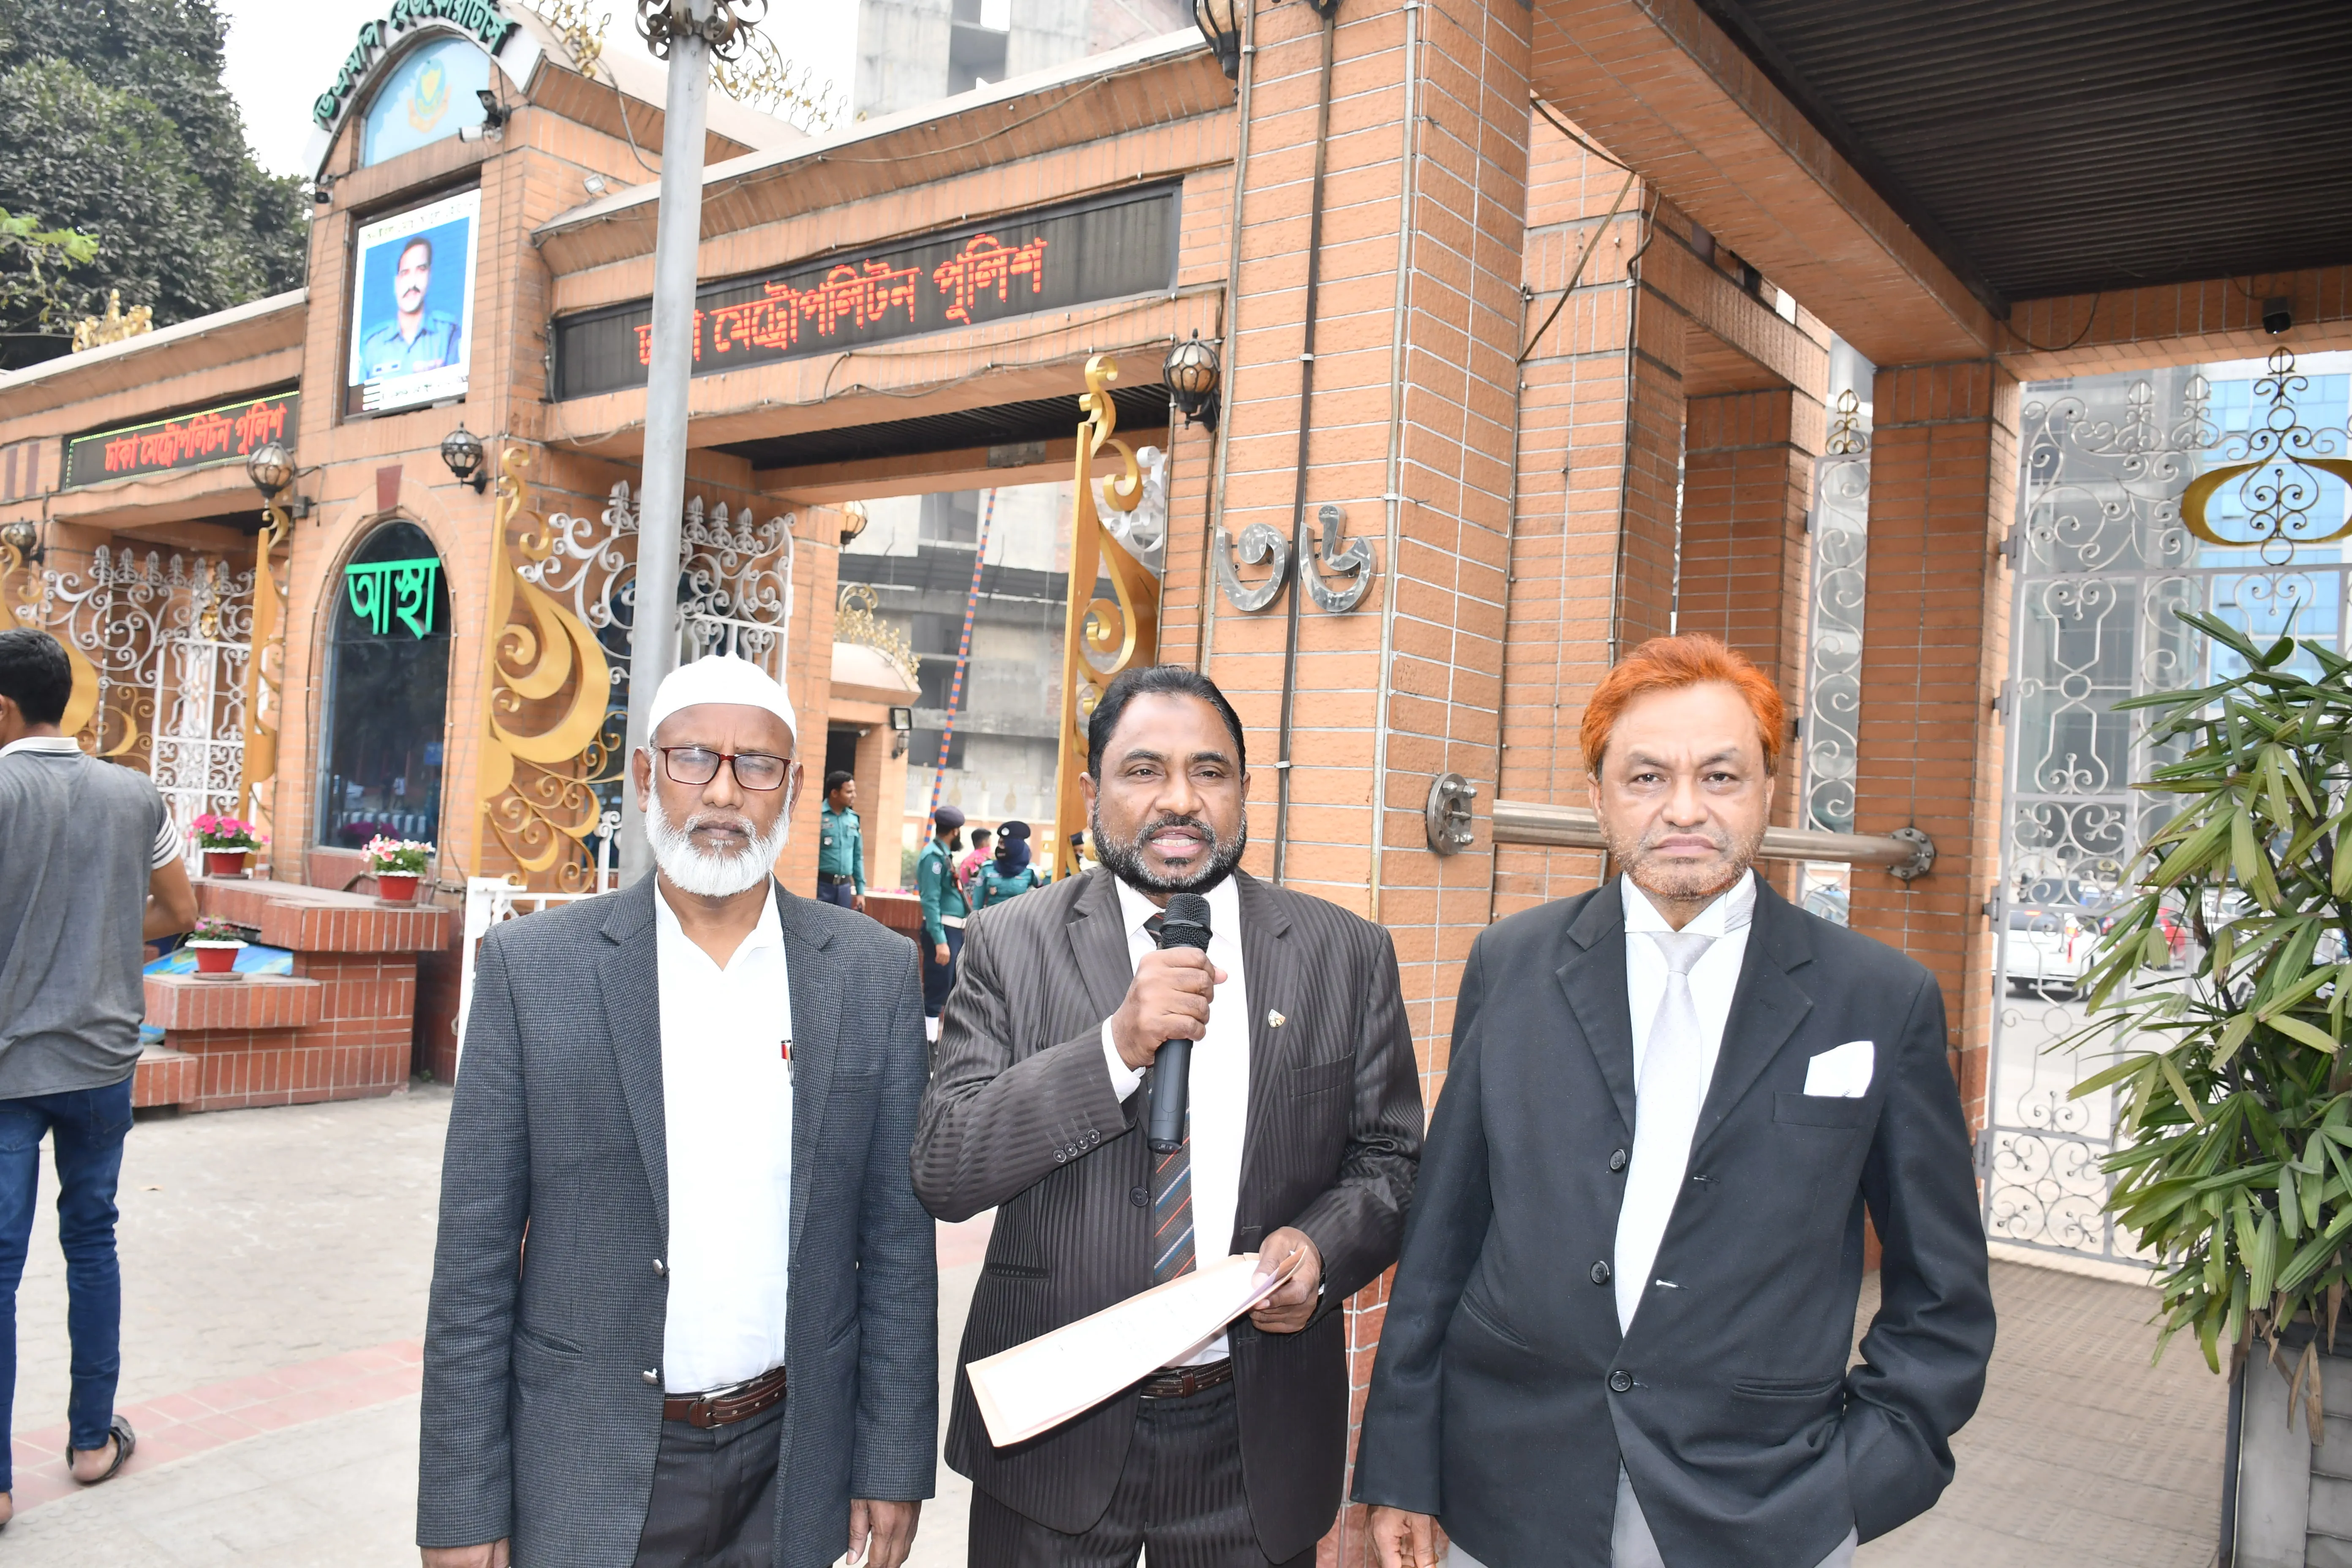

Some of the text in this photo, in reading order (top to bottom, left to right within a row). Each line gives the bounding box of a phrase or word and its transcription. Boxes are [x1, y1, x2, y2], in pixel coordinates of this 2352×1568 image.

[933, 234, 1048, 325] পুলিশ
[105, 433, 140, 472] ঢাকা
[345, 557, 440, 640] আস্থা
[1216, 505, 1376, 612] ৩৬
